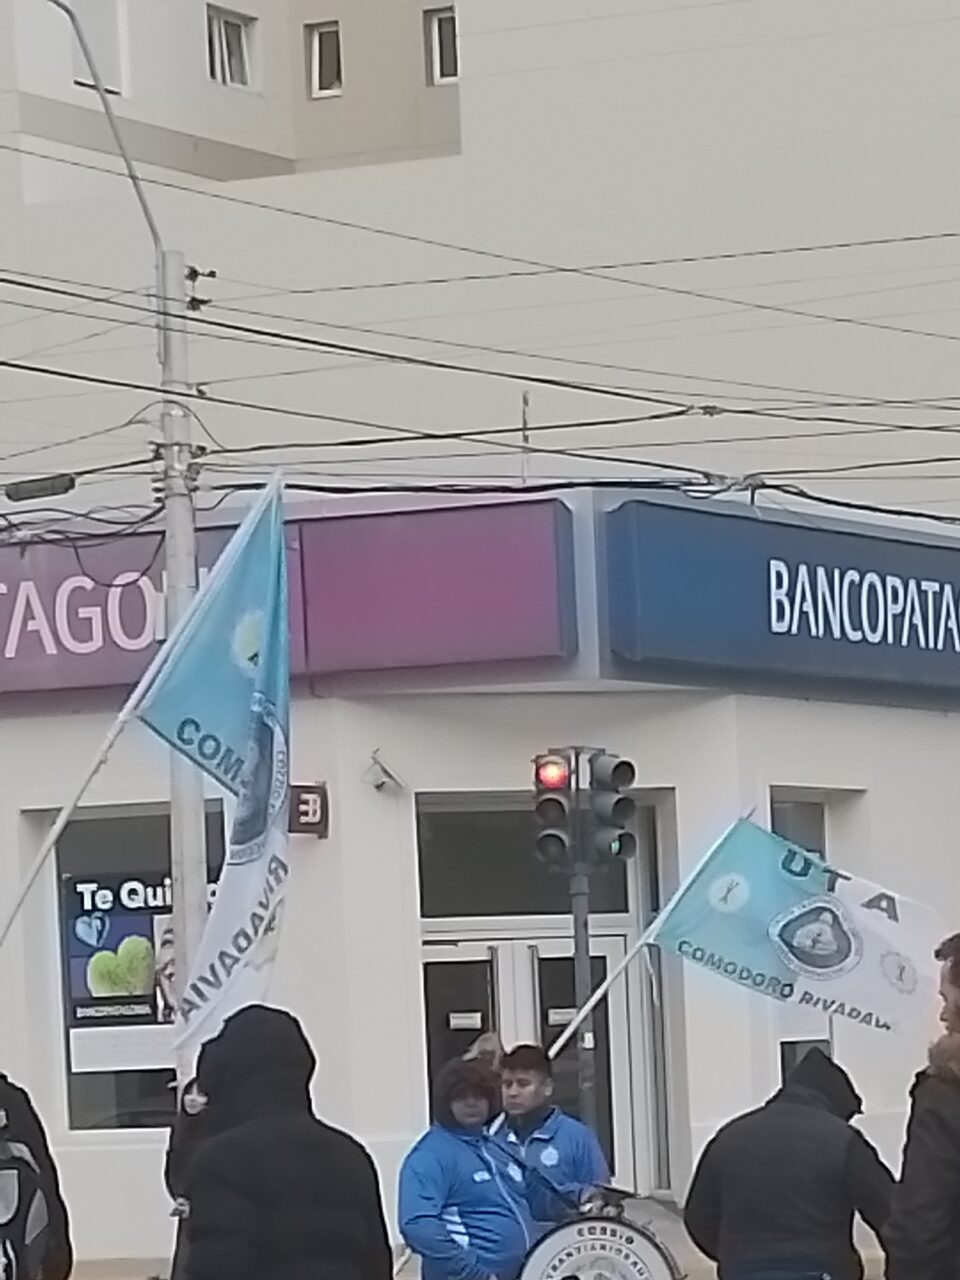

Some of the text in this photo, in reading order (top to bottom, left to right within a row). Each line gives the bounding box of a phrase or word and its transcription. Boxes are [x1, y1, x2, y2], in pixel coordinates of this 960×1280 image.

[0, 567, 208, 658] AGO
[176, 717, 245, 782] COM
[76, 883, 113, 910] Te
[120, 877, 172, 908] Qui
[780, 848, 900, 923] UTA
[677, 940, 795, 999] COMODORO
[798, 991, 891, 1031] RIVADAV
